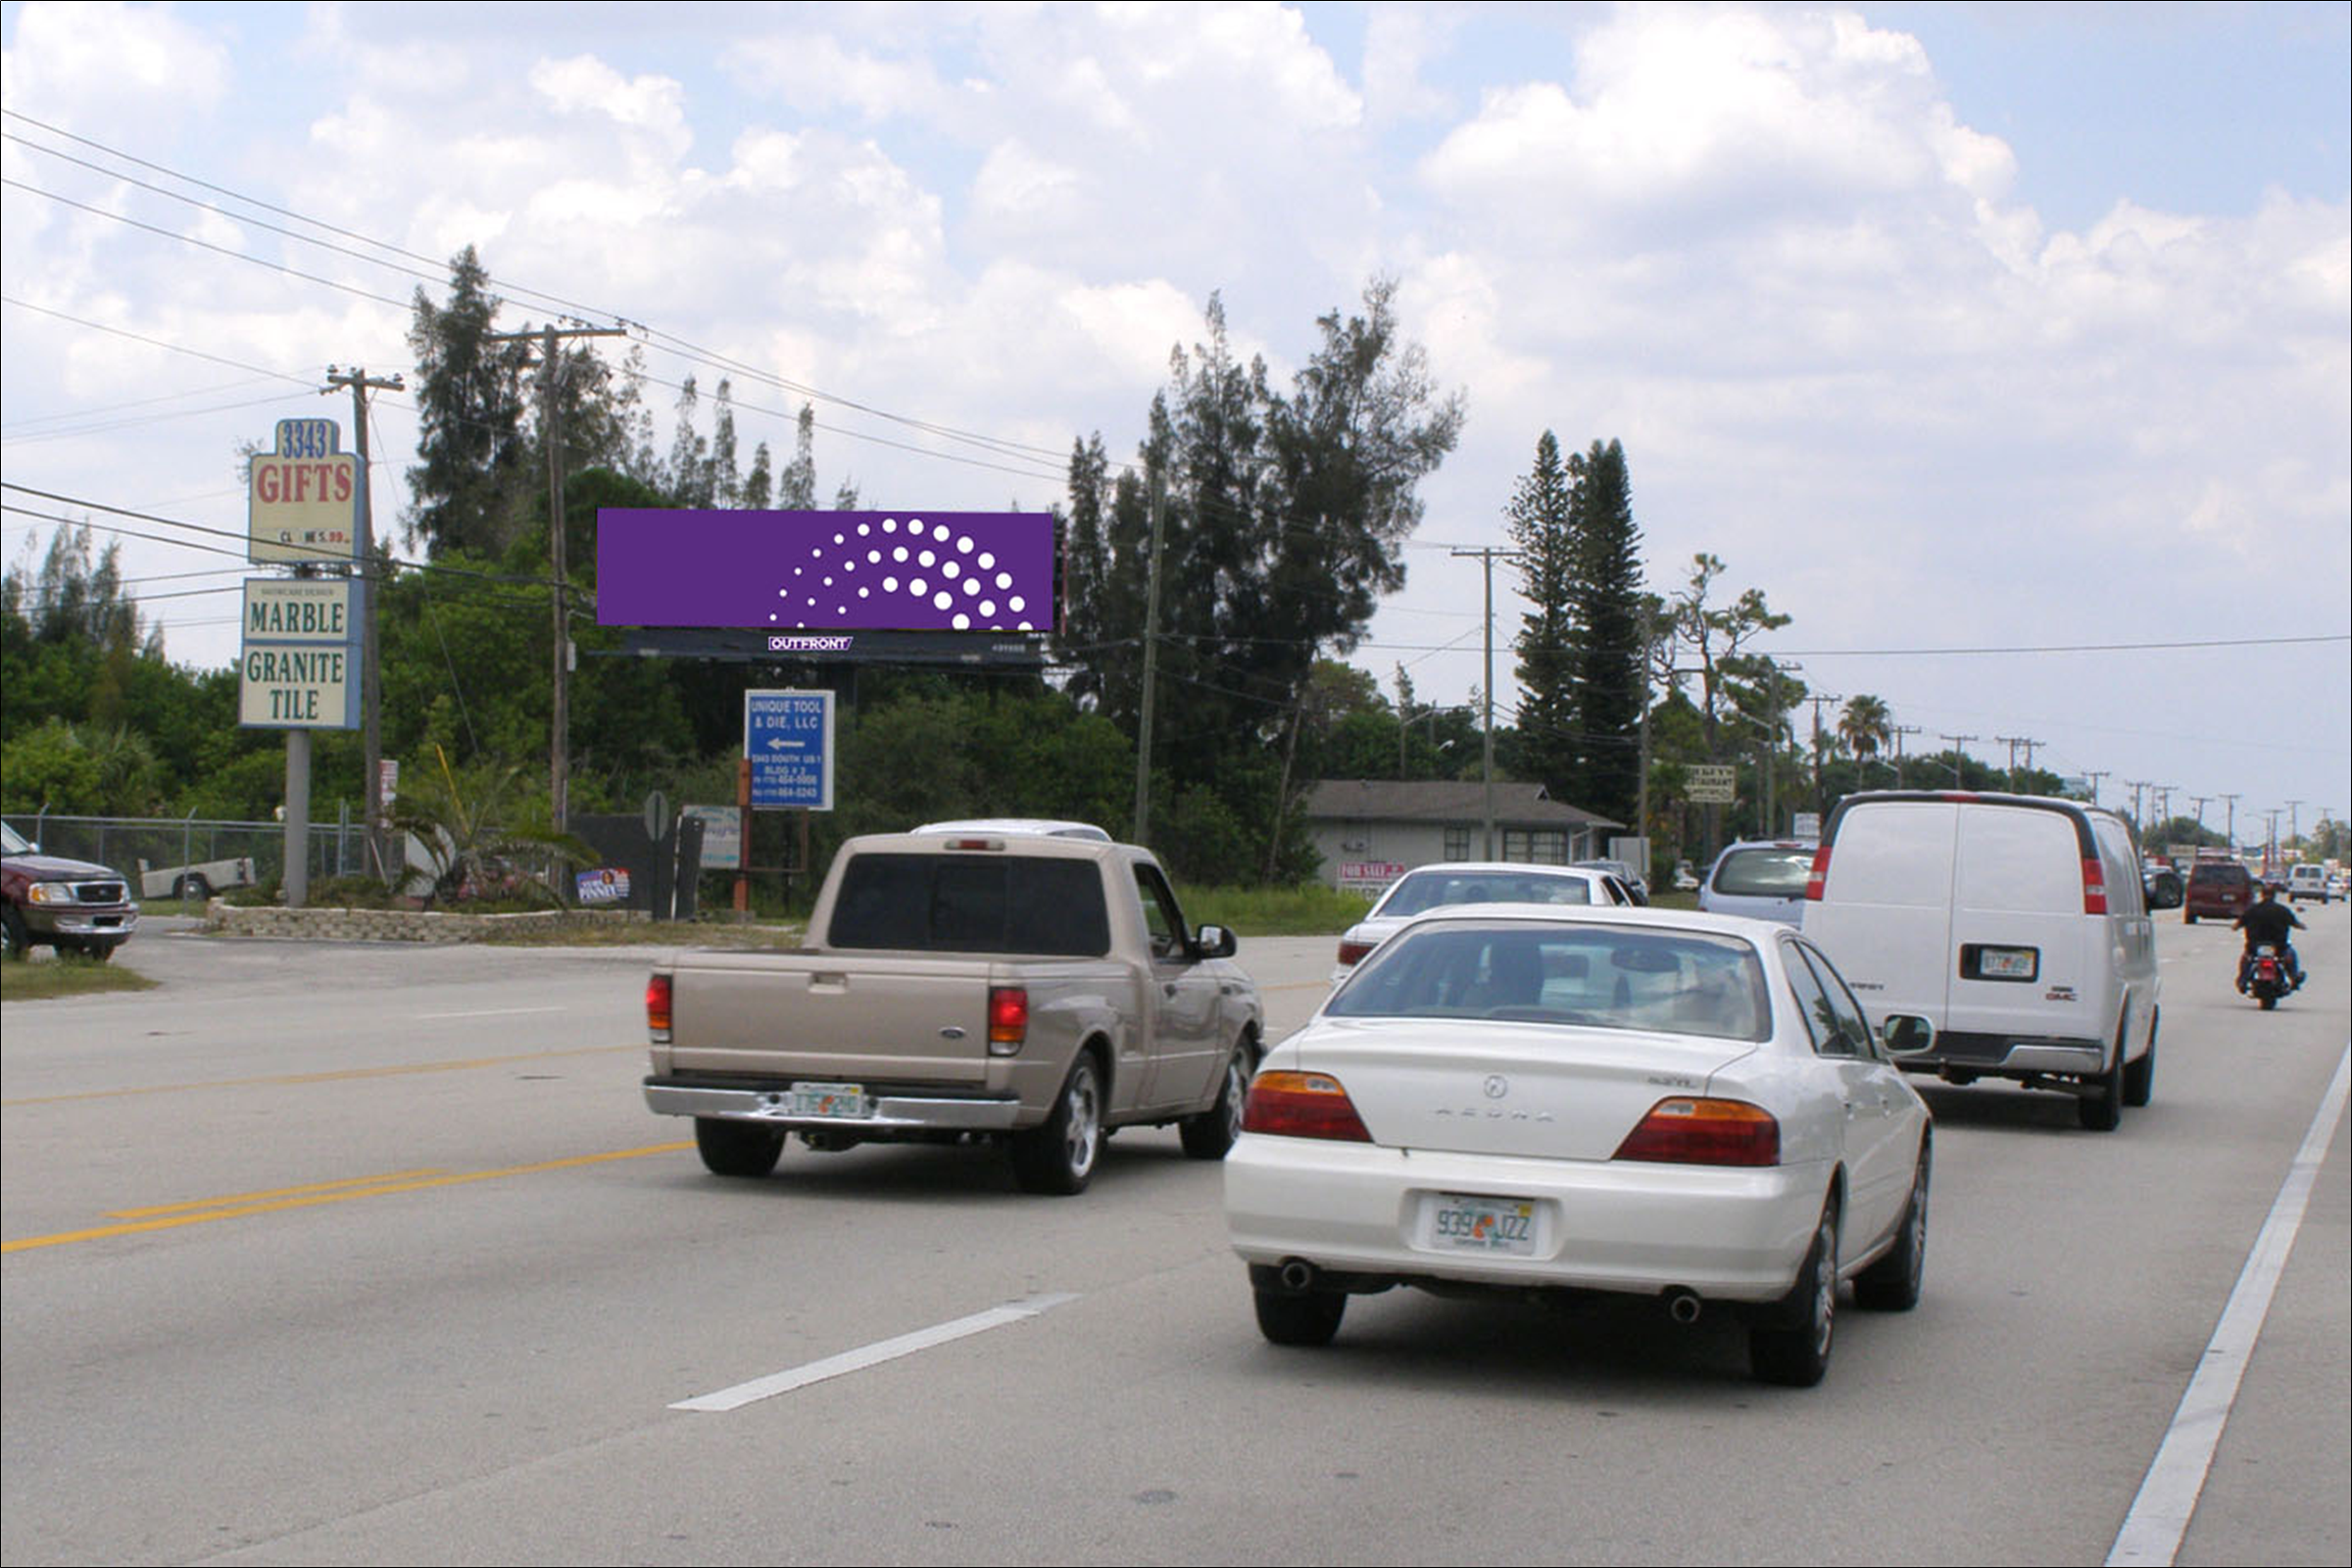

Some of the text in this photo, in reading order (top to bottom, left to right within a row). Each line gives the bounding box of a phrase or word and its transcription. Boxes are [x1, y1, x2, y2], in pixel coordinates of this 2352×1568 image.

[282, 421, 327, 460] 3343
[257, 464, 352, 504] GIFTS
[250, 602, 344, 634] MARBLE
[771, 637, 848, 650] OUTFRONT
[247, 651, 343, 684] GRANITE
[270, 689, 319, 720] TILE
[751, 701, 821, 713] UNIQUE TOOL
[795, 716, 818, 729] LLC
[2045, 992, 2078, 1002] GMC
[1438, 1209, 1473, 1237] 939
